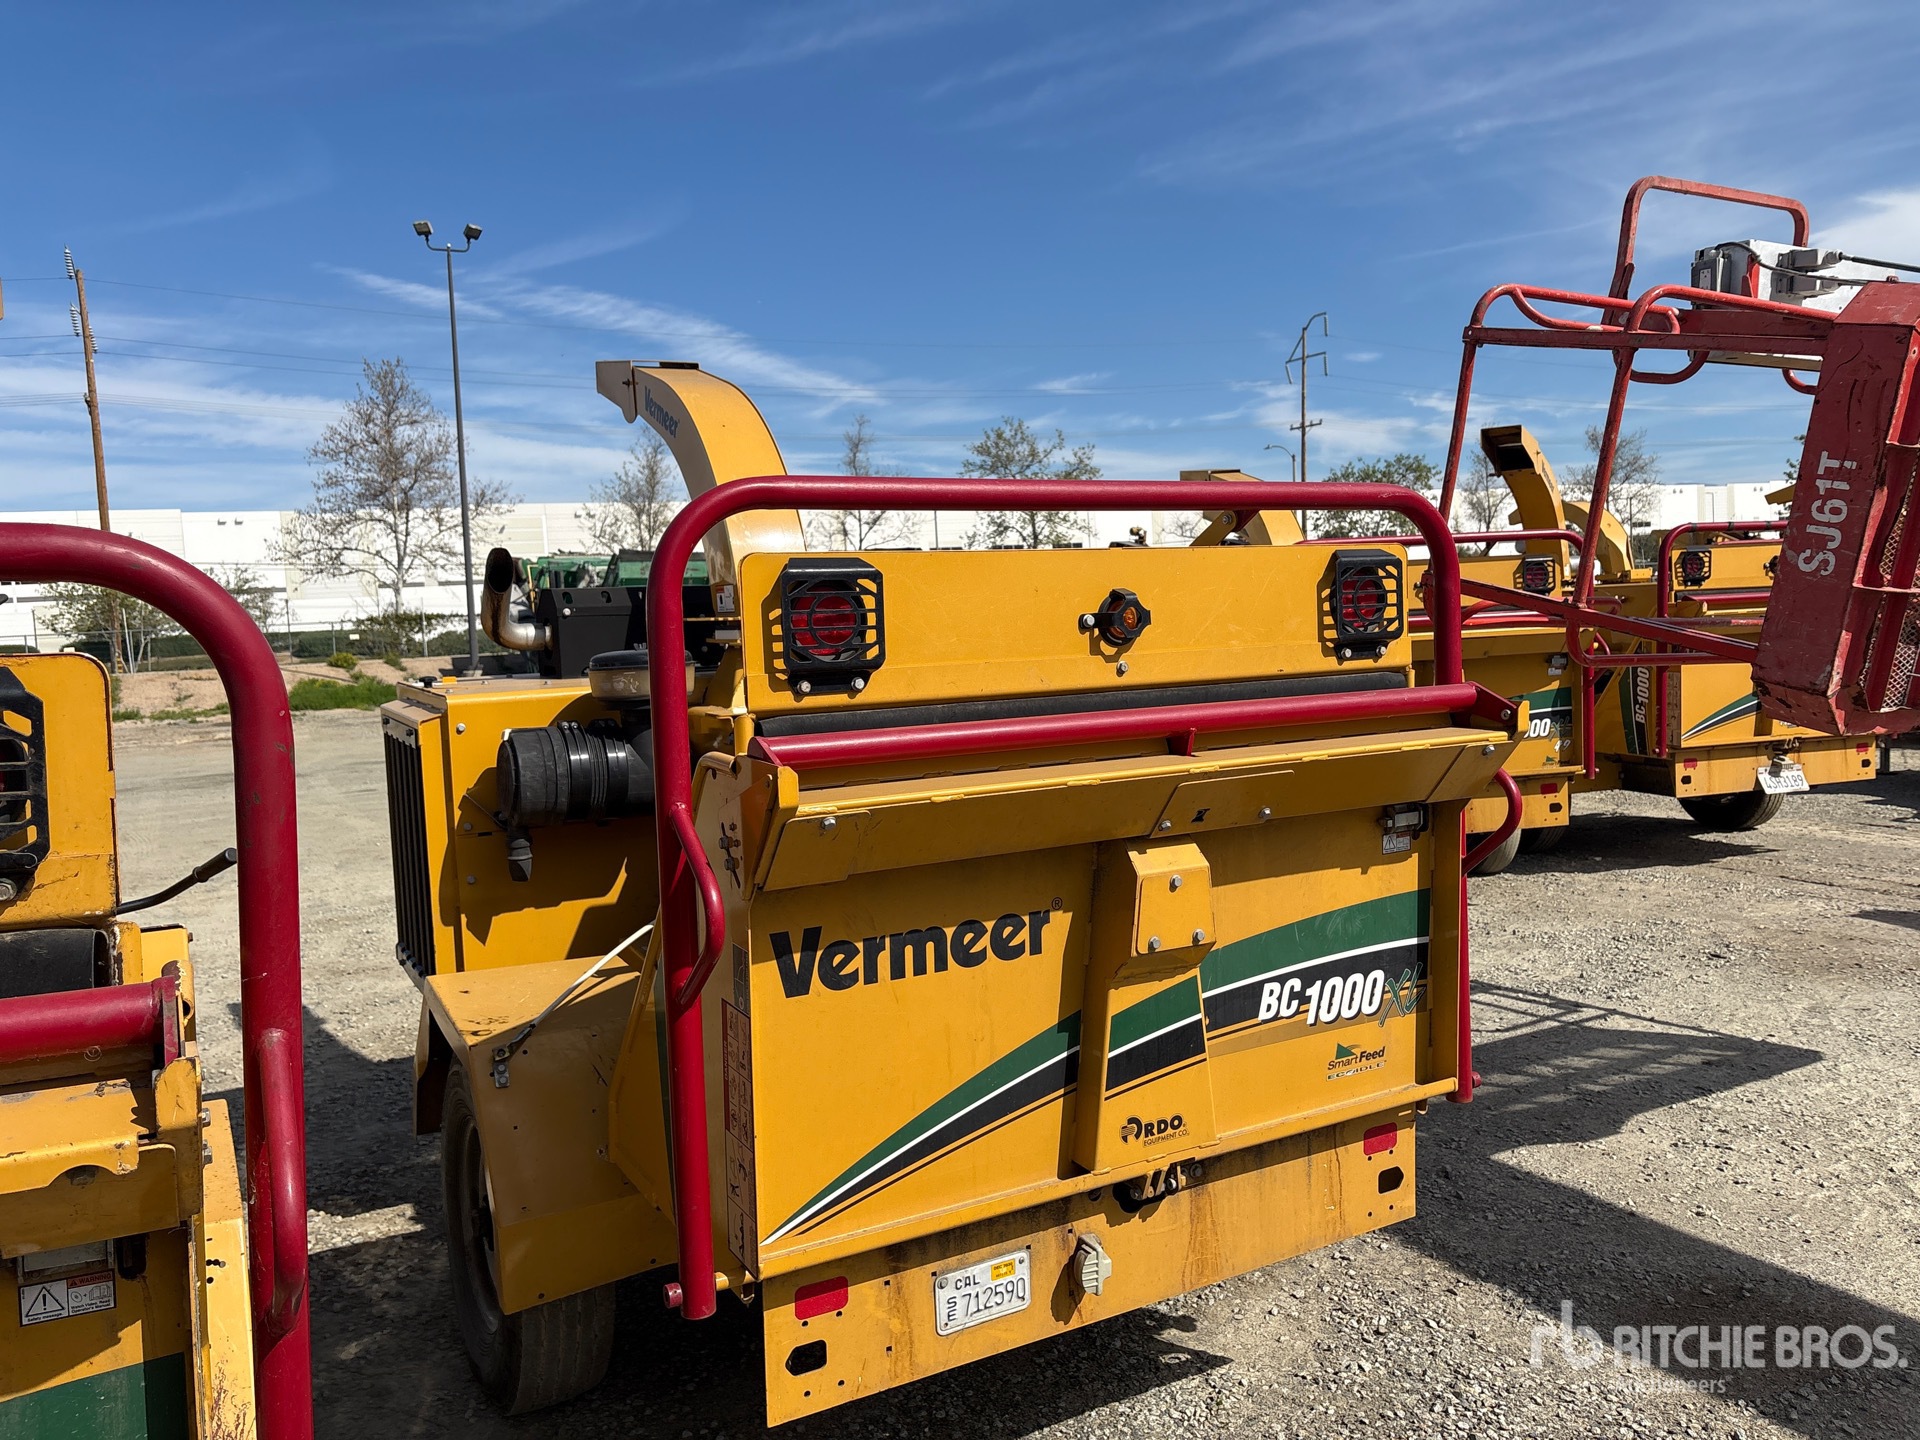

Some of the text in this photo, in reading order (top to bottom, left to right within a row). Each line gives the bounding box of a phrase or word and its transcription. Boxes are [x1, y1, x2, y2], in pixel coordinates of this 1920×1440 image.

[645, 385, 677, 438] Vermeer
[1797, 450, 1857, 576] SJ61T
[769, 908, 1051, 999] Vermeer
[1143, 1131, 1177, 1147] EQUIPMENT
[80, 1272, 112, 1286] WARNING
[955, 1274, 980, 1291] CAL
